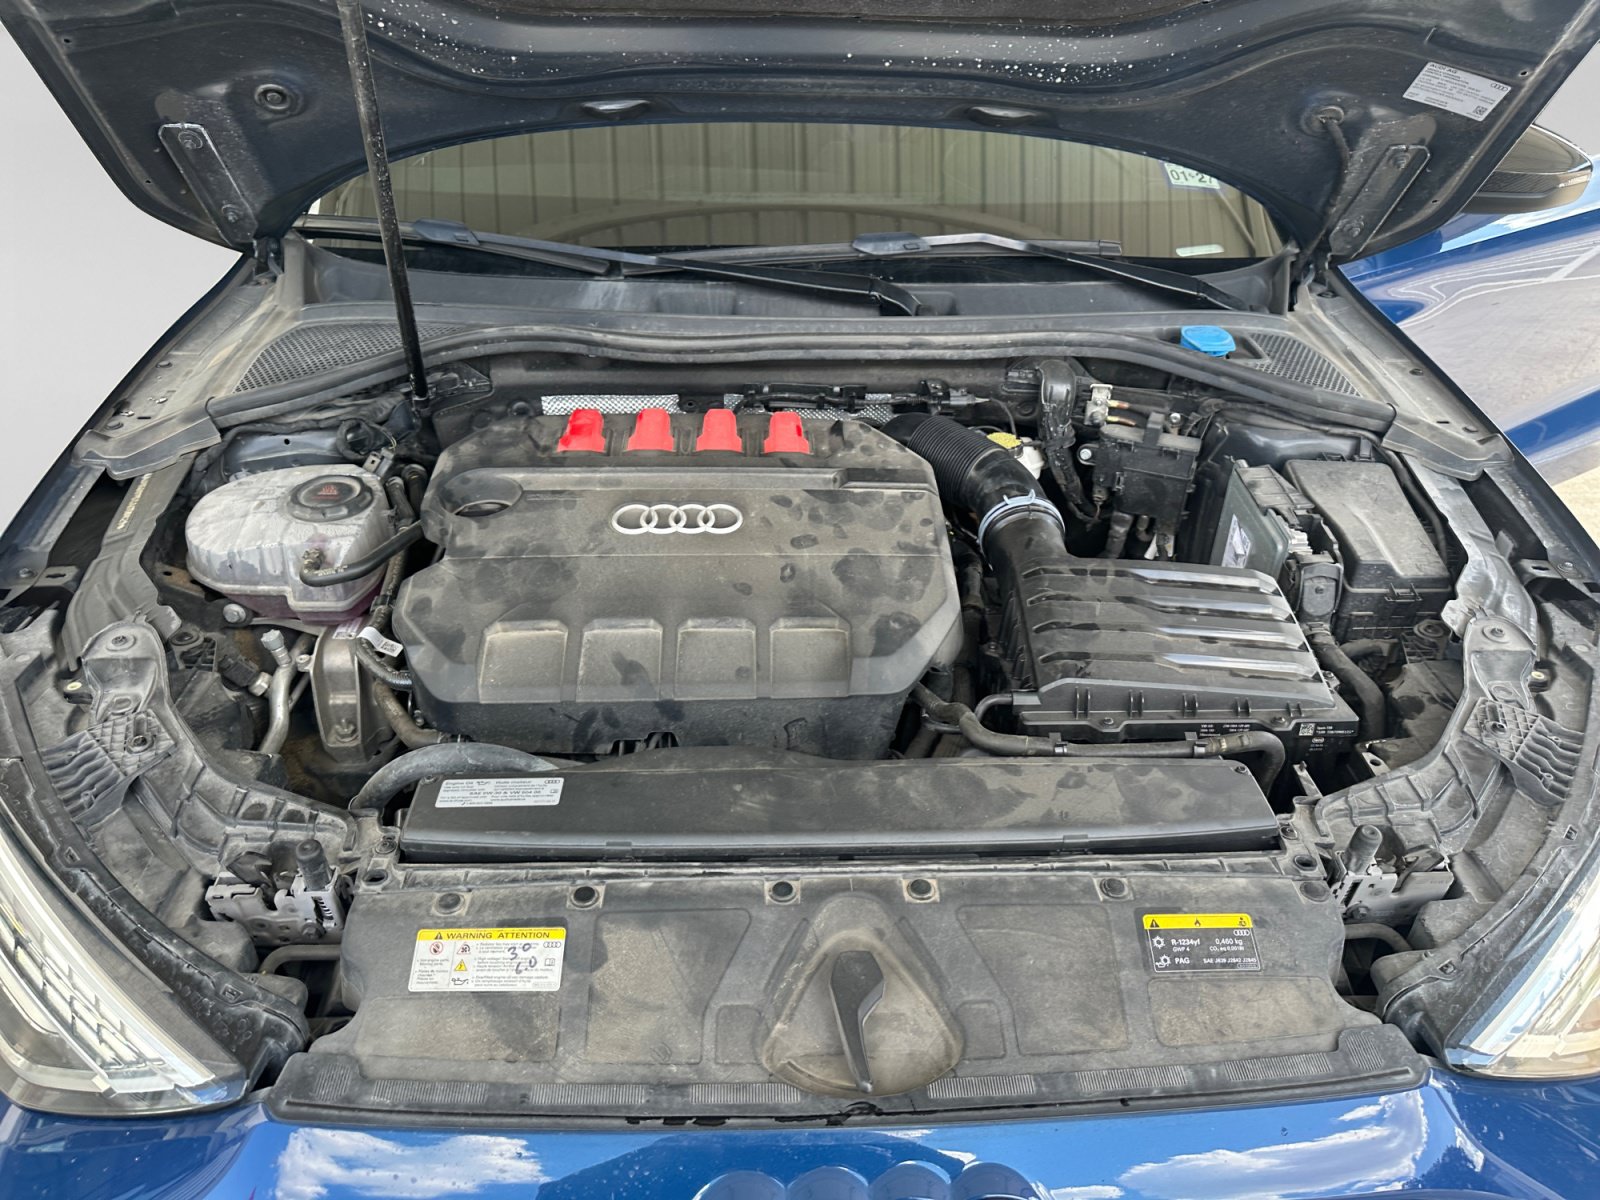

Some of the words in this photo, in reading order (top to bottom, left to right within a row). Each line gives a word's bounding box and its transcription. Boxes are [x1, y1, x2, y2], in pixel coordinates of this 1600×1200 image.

[1170, 169, 1188, 182] 01
[446, 932, 493, 940] WARNING
[497, 931, 551, 939] ATTENTION
[1170, 938, 1201, 947] R-1234yf
[1174, 957, 1191, 965] PAG
